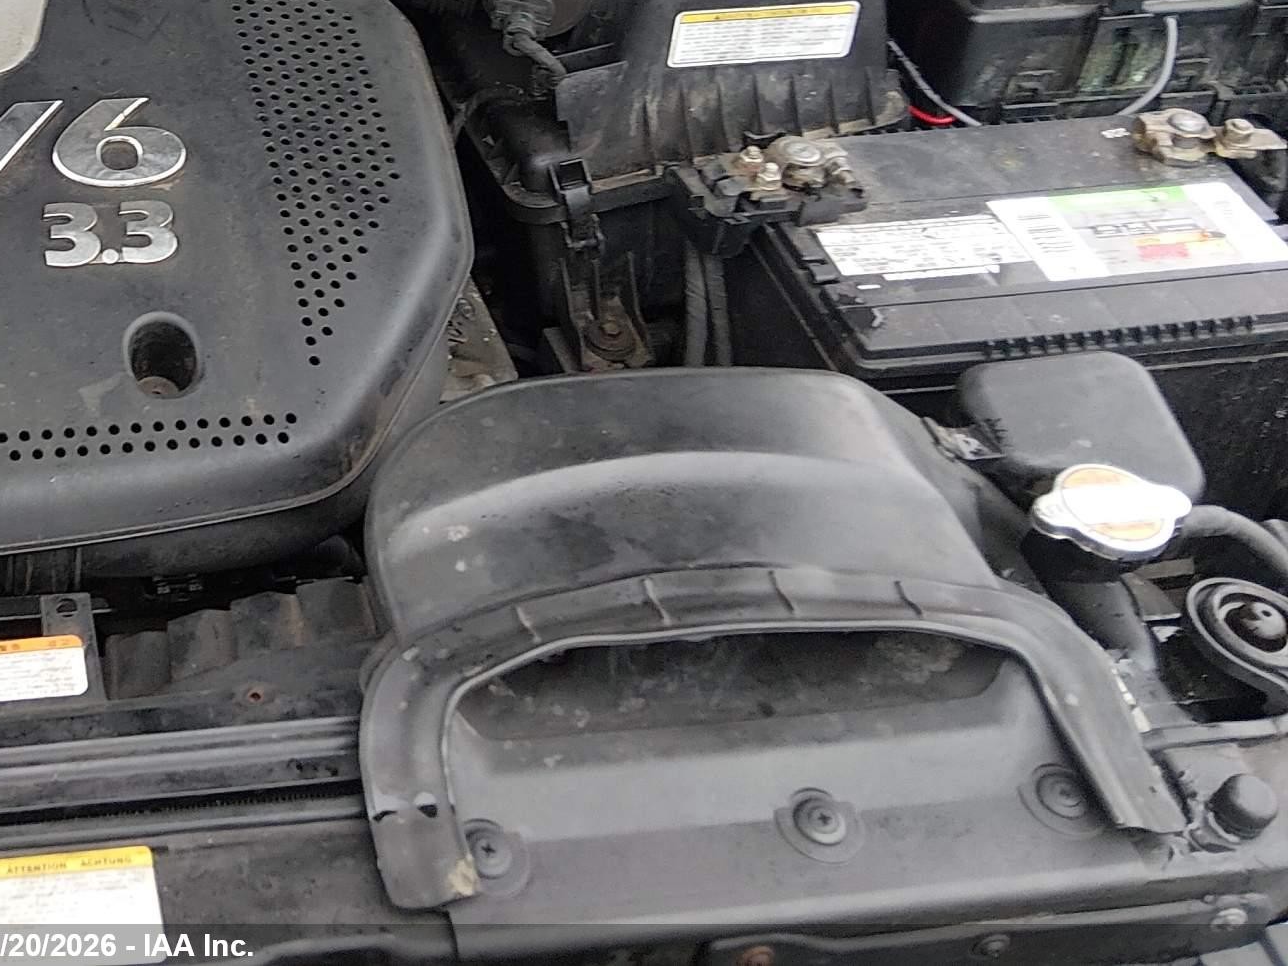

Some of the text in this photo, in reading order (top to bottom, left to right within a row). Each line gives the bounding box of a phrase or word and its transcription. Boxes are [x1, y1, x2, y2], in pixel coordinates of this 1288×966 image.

[42, 200, 179, 267] 3.3
[7, 862, 67, 874] ATTENTION
[81, 855, 132, 868] ACHTUNG
